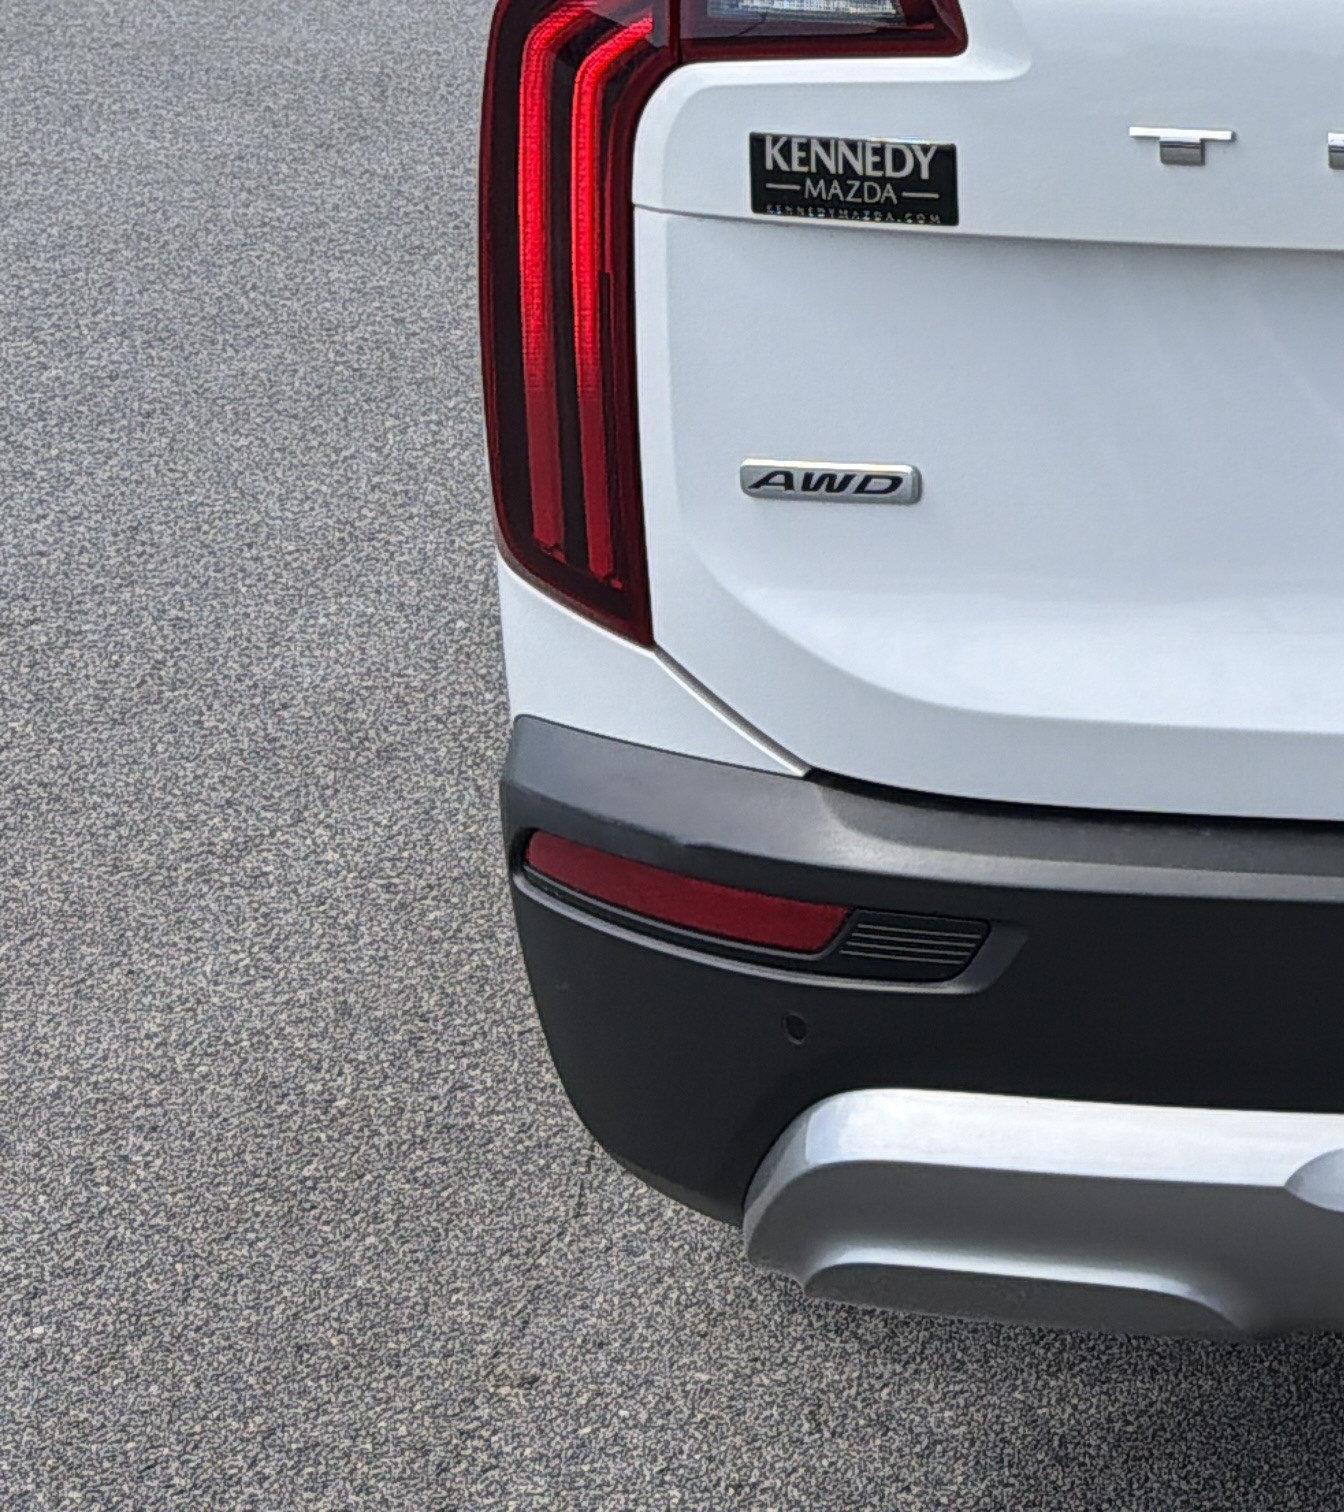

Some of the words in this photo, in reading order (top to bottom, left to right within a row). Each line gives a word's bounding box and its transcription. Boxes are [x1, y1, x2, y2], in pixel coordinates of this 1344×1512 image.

[765, 135, 938, 180] KENNEDY
[804, 177, 898, 205] MAZDA
[748, 470, 904, 495] AWD
